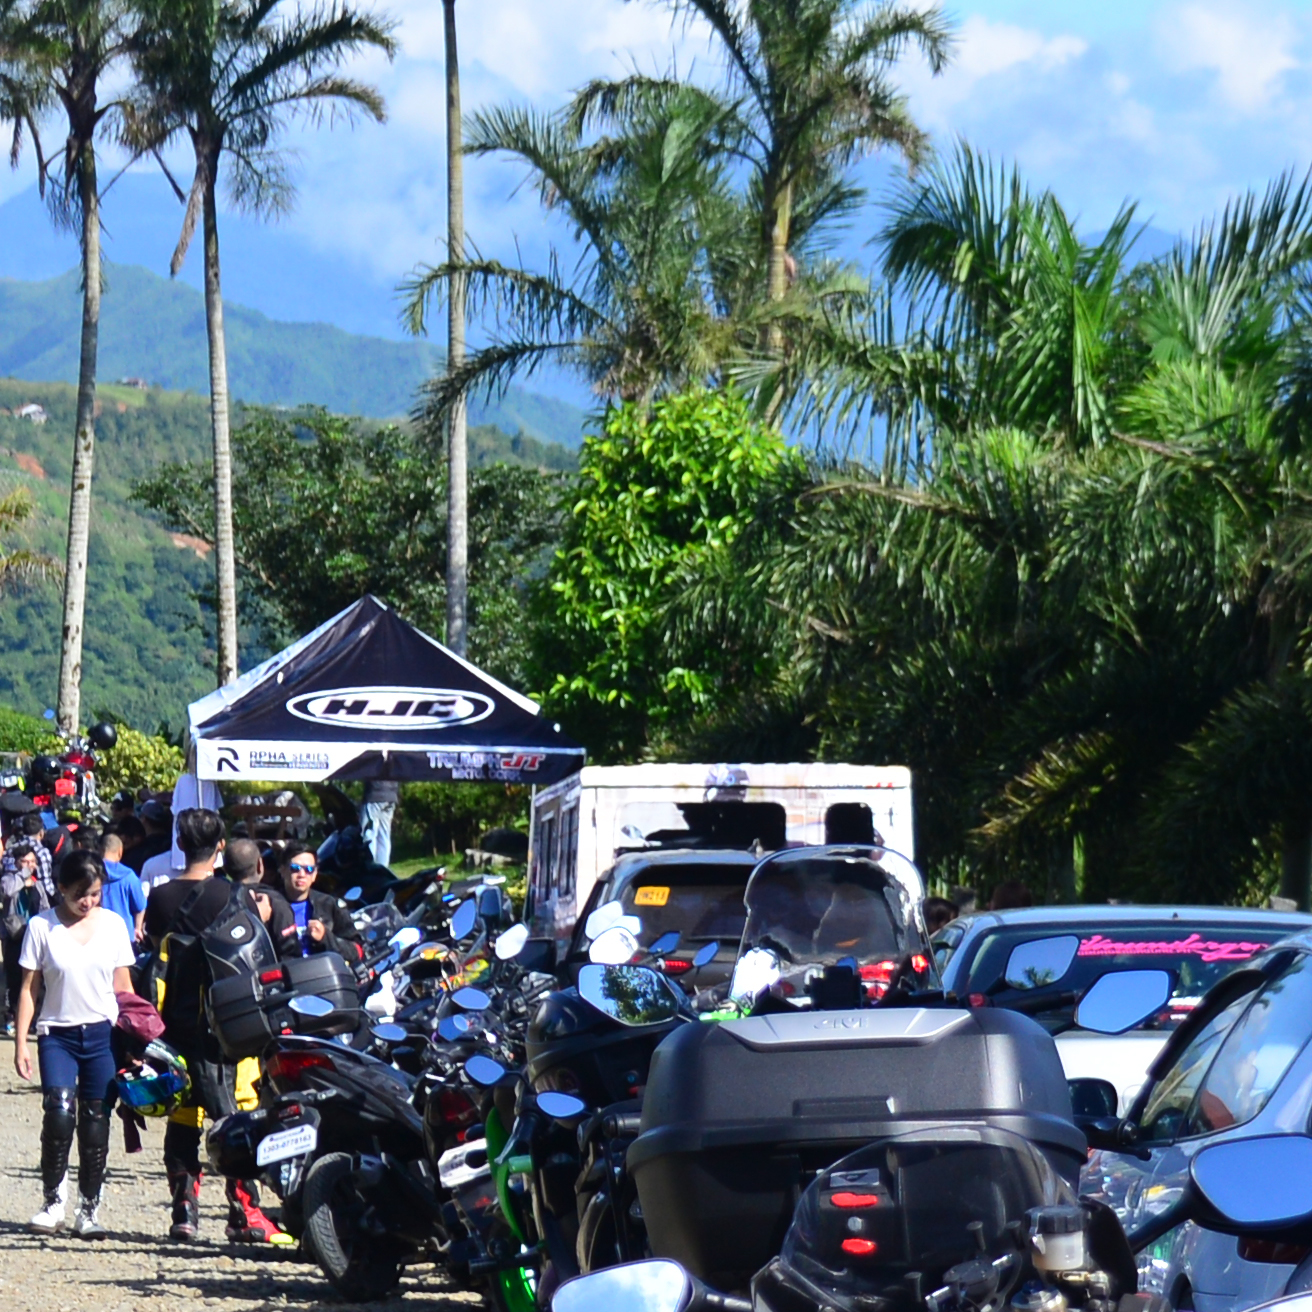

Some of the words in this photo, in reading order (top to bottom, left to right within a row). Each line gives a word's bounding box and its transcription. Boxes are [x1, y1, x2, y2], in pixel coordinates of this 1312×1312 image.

[321, 698, 459, 718] HJC
[249, 750, 287, 761] RPHA
[426, 752, 501, 769] TRIUMPH
